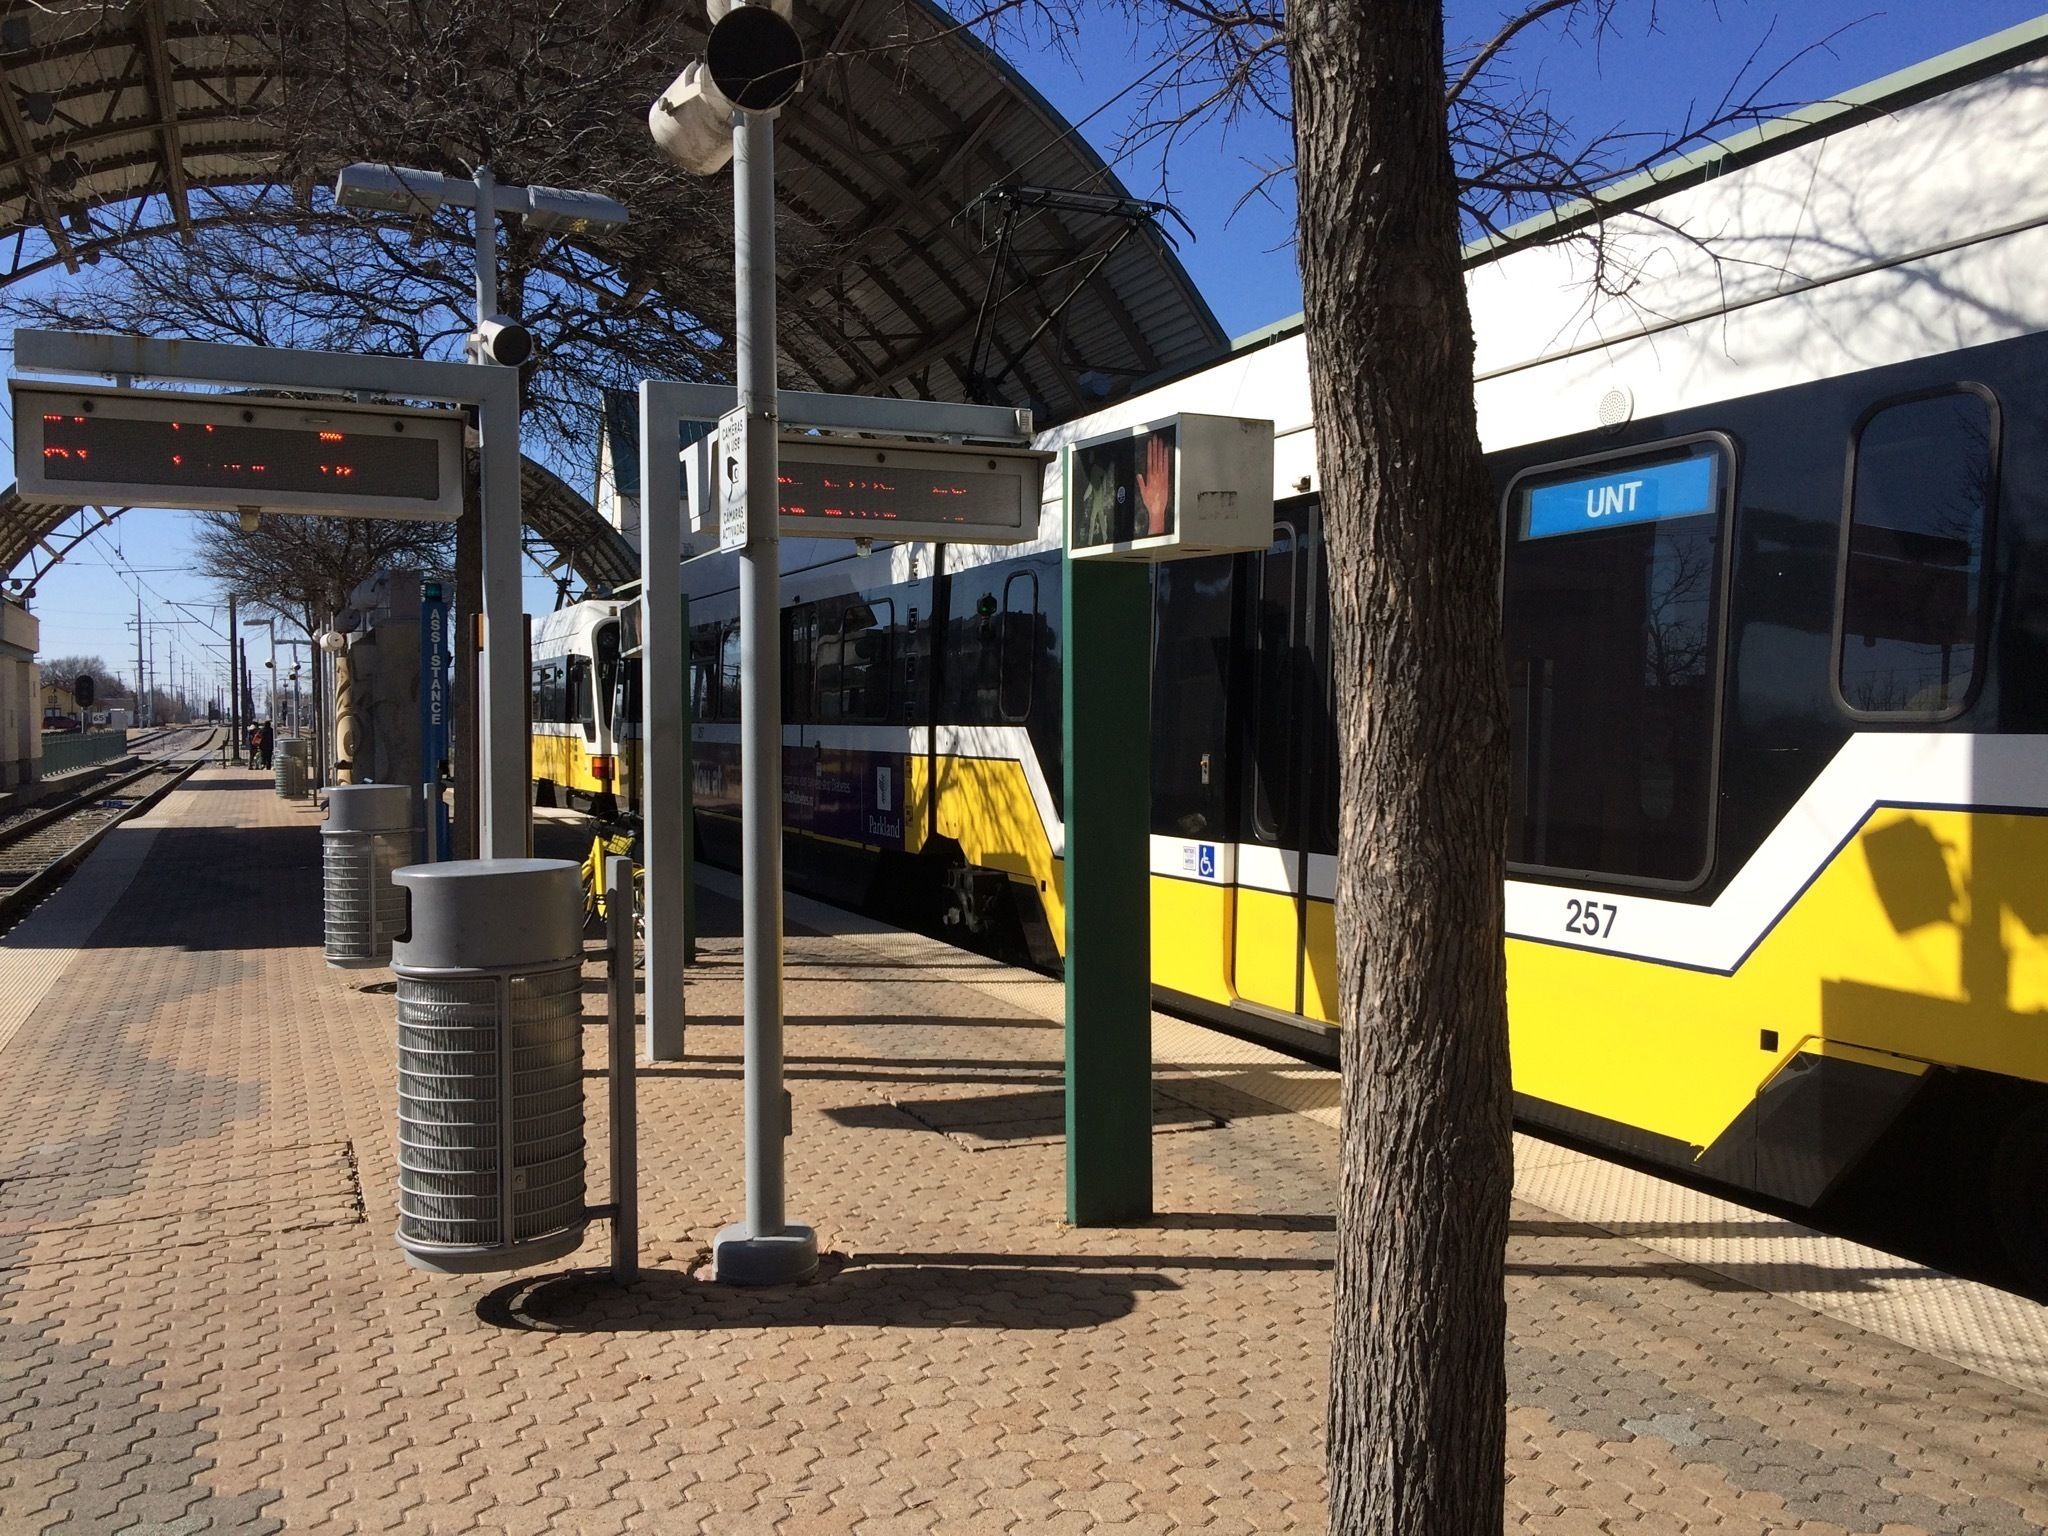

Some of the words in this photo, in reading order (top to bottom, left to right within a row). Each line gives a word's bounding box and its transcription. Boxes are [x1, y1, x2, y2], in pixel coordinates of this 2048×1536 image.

[722, 419, 743, 441] CAMERAS
[731, 436, 740, 452] USE
[1586, 481, 1643, 518] UNT
[430, 608, 441, 725] ASSISTANCE
[93, 714, 105, 722] 65
[869, 815, 901, 839] Parkland
[1566, 898, 1617, 938] 257
